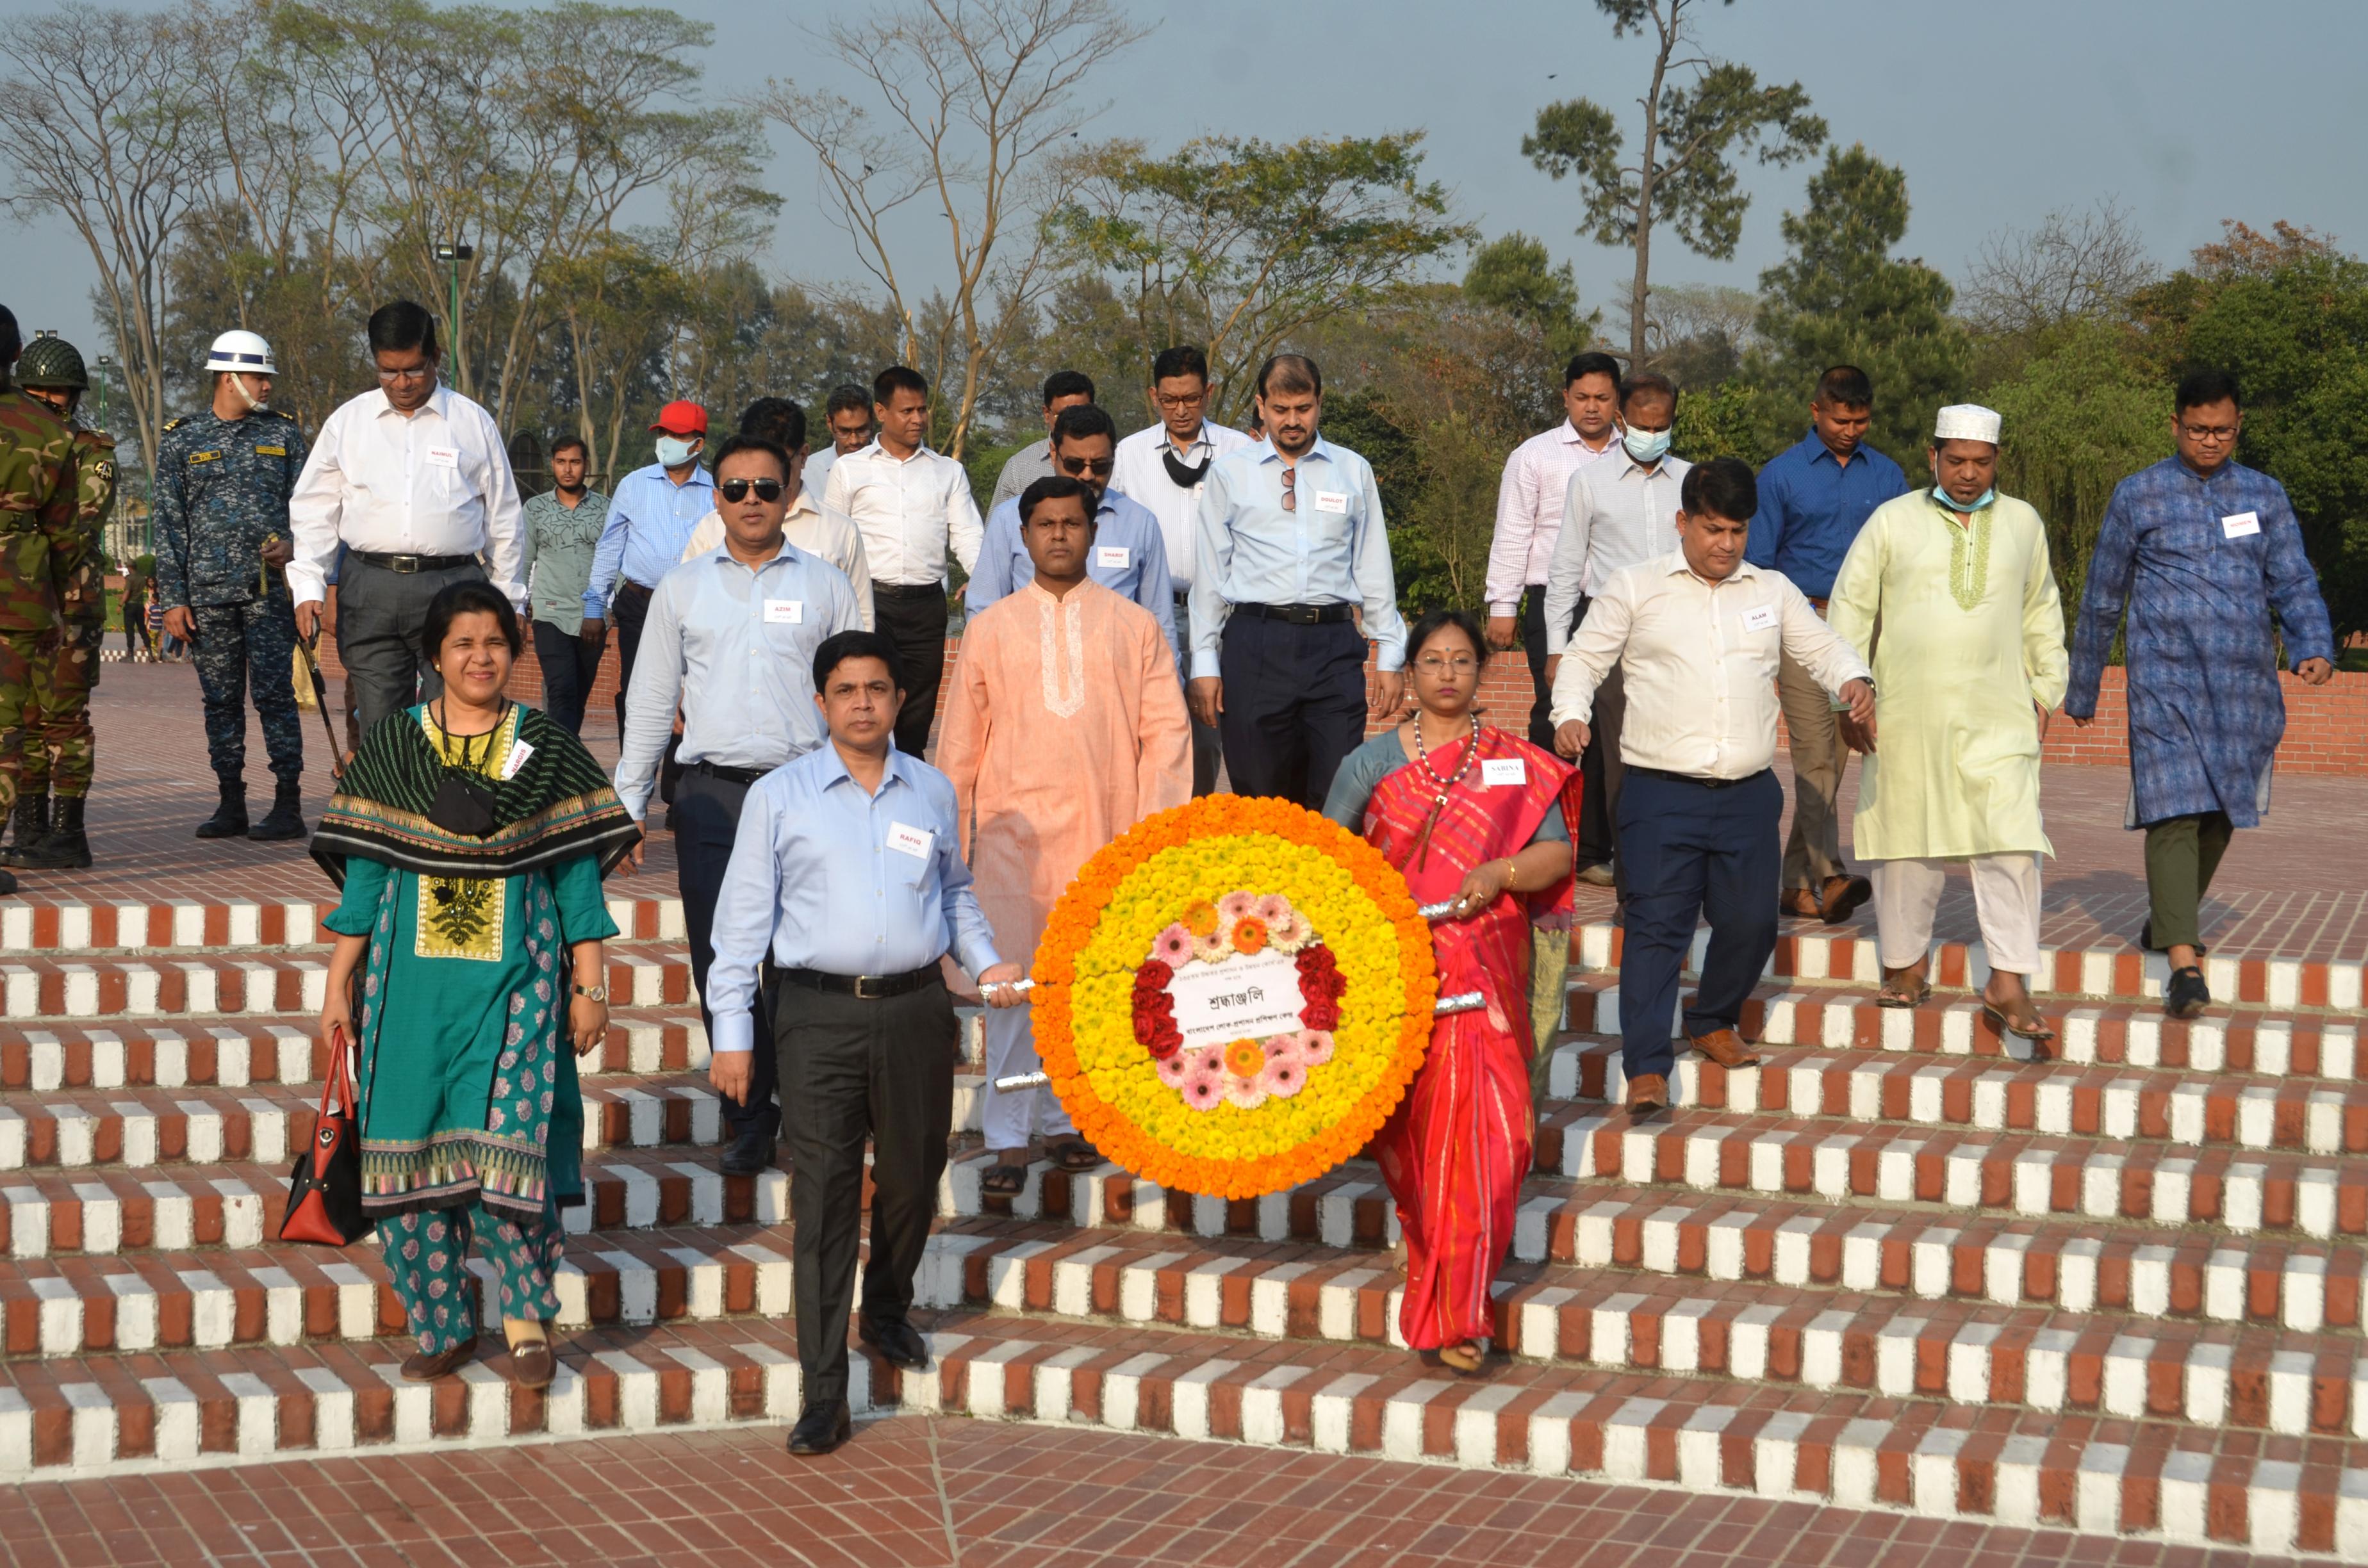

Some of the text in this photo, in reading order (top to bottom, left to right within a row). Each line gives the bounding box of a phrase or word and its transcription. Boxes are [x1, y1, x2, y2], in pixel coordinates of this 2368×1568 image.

[511, 749, 526, 772] NARGIS
[900, 834, 921, 845] RAFIQ
[1208, 986, 1264, 1009] শ্রদ্ধাঞ্জলি
[1187, 1025, 1214, 1034] বাংলাদেশ
[1256, 1014, 1277, 1024] প্রশিক্ষণ
